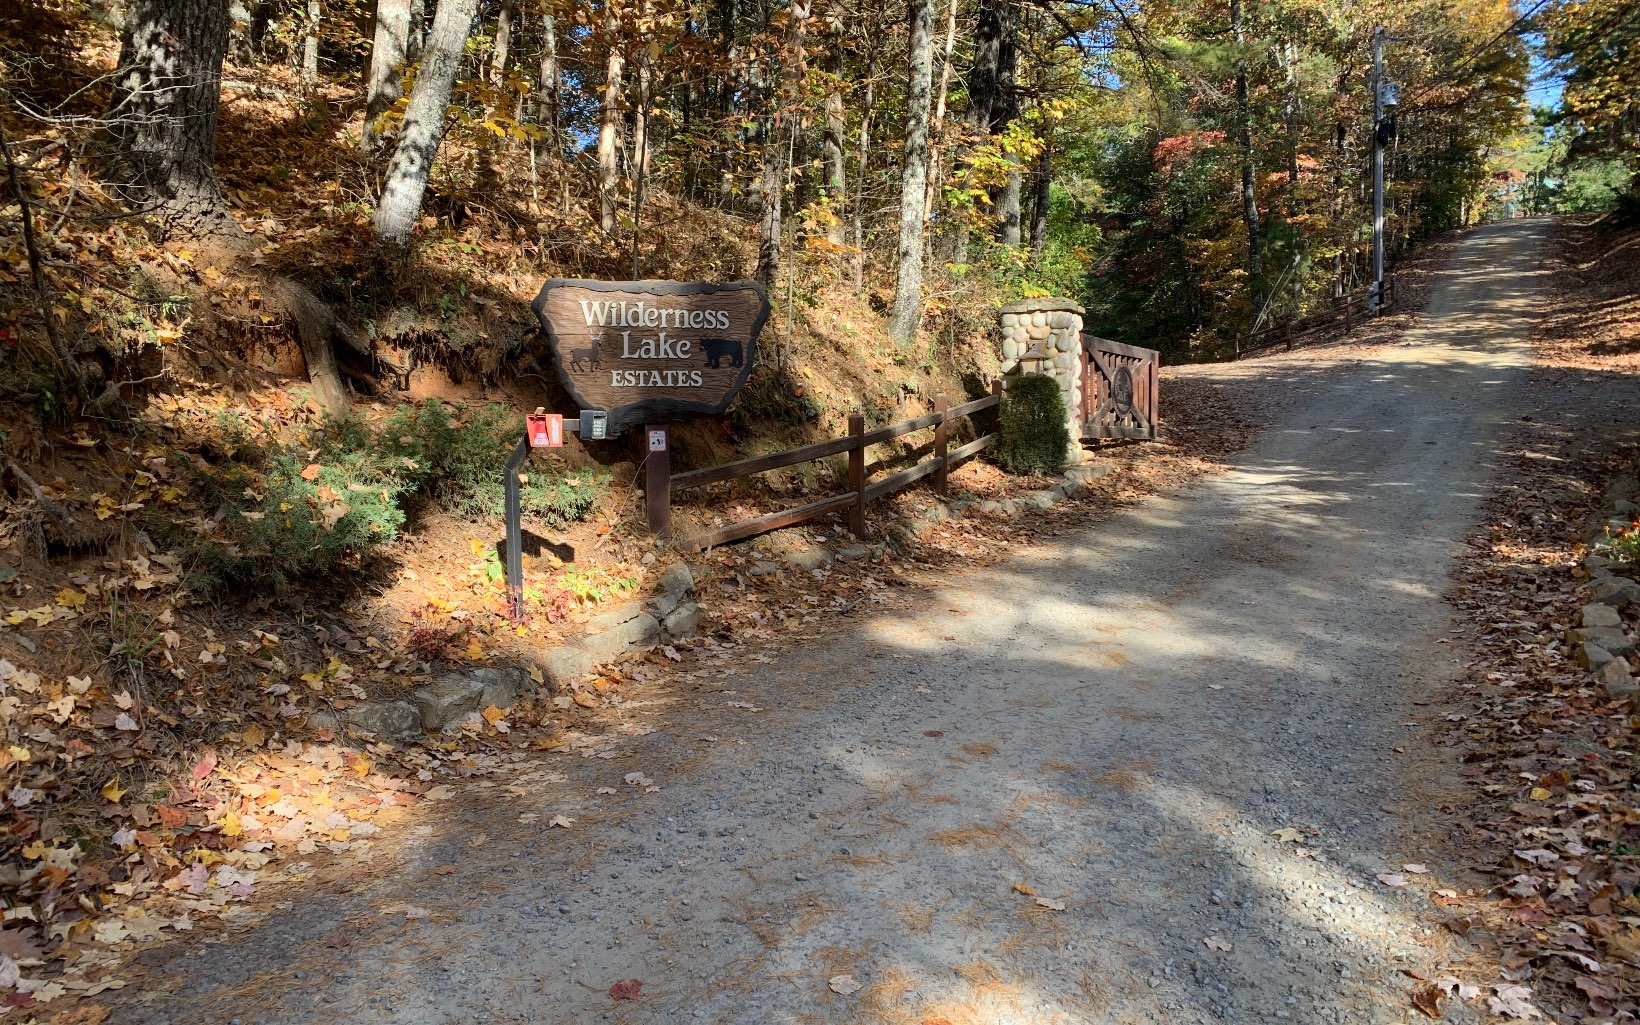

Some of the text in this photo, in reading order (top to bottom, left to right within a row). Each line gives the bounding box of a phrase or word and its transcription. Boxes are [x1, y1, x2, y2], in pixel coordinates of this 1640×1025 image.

[579, 300, 729, 329] Wilderness
[621, 331, 691, 359] Lake
[611, 370, 702, 387] ESTATES
